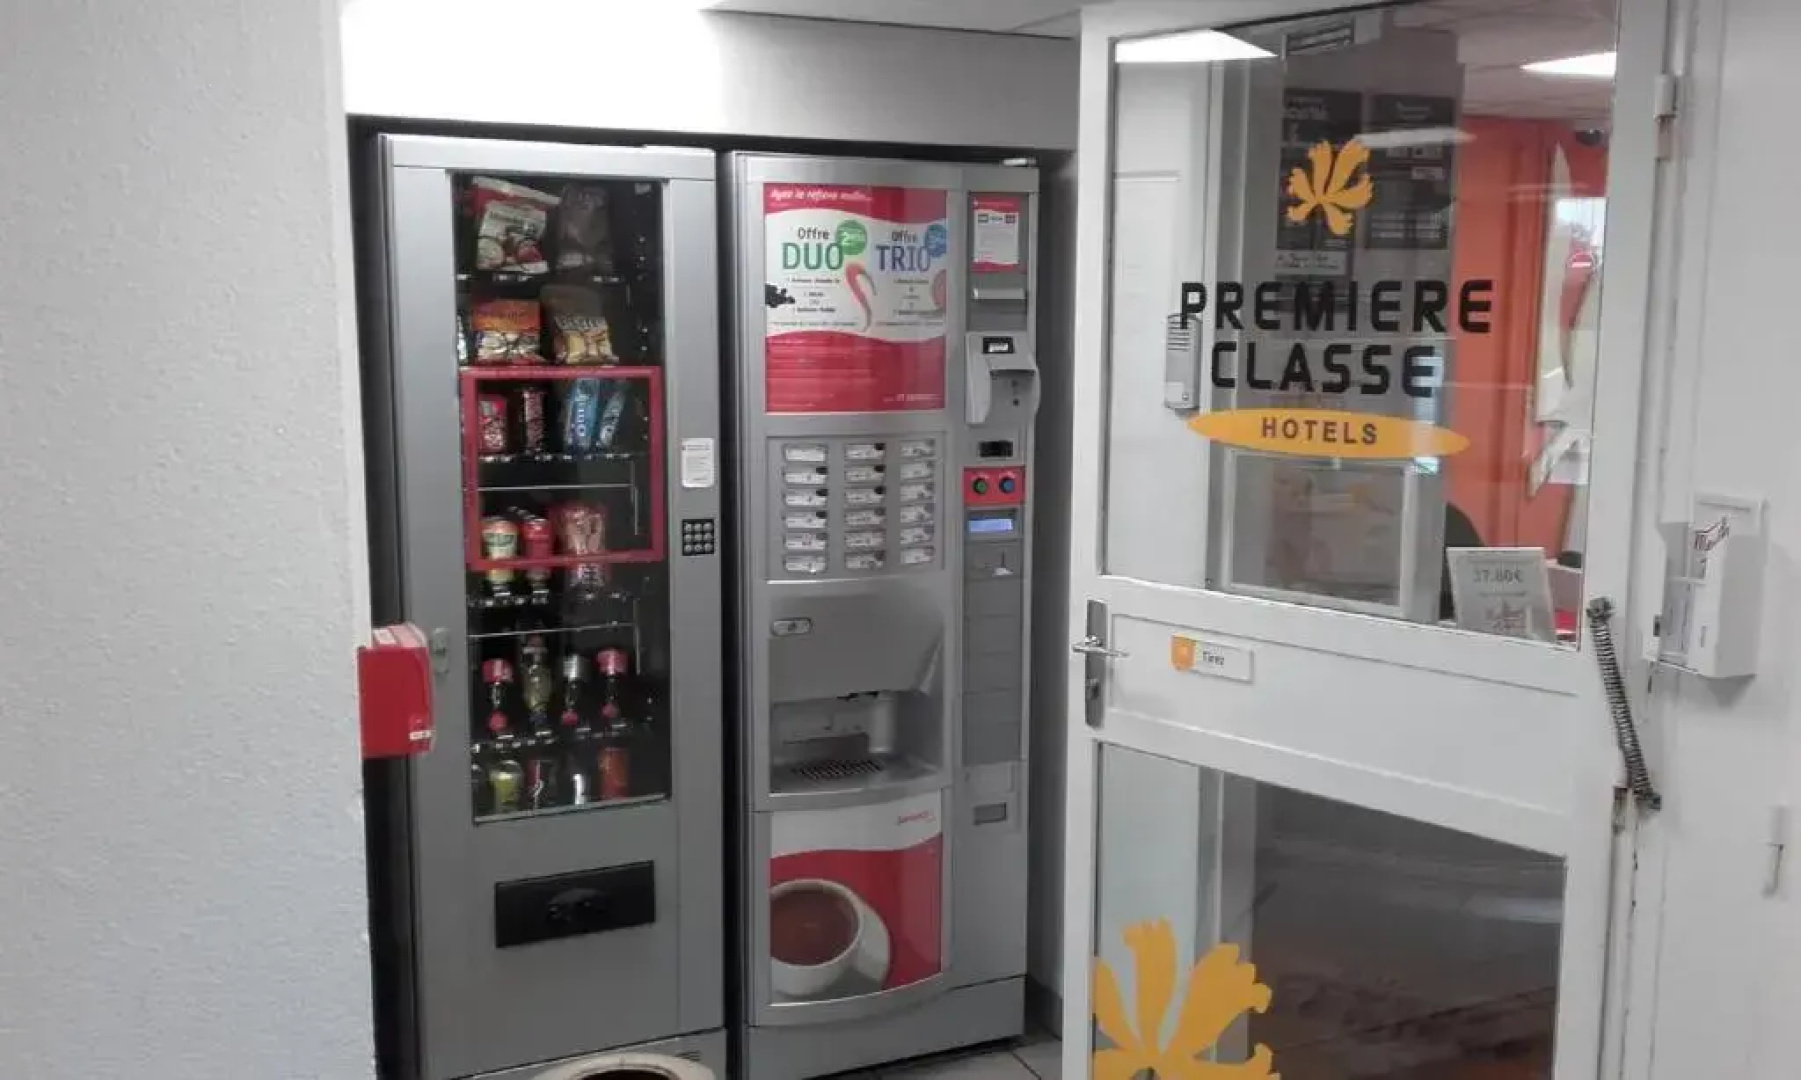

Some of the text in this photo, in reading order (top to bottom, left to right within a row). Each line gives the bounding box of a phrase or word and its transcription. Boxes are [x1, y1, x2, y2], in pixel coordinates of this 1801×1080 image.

[797, 227, 830, 240] Offre
[782, 242, 843, 270] DUO
[875, 245, 931, 272] TRIO
[1181, 279, 1493, 334] PREMIERE
[1211, 341, 1436, 398] CLASSE
[1261, 417, 1378, 445] HOTELS
